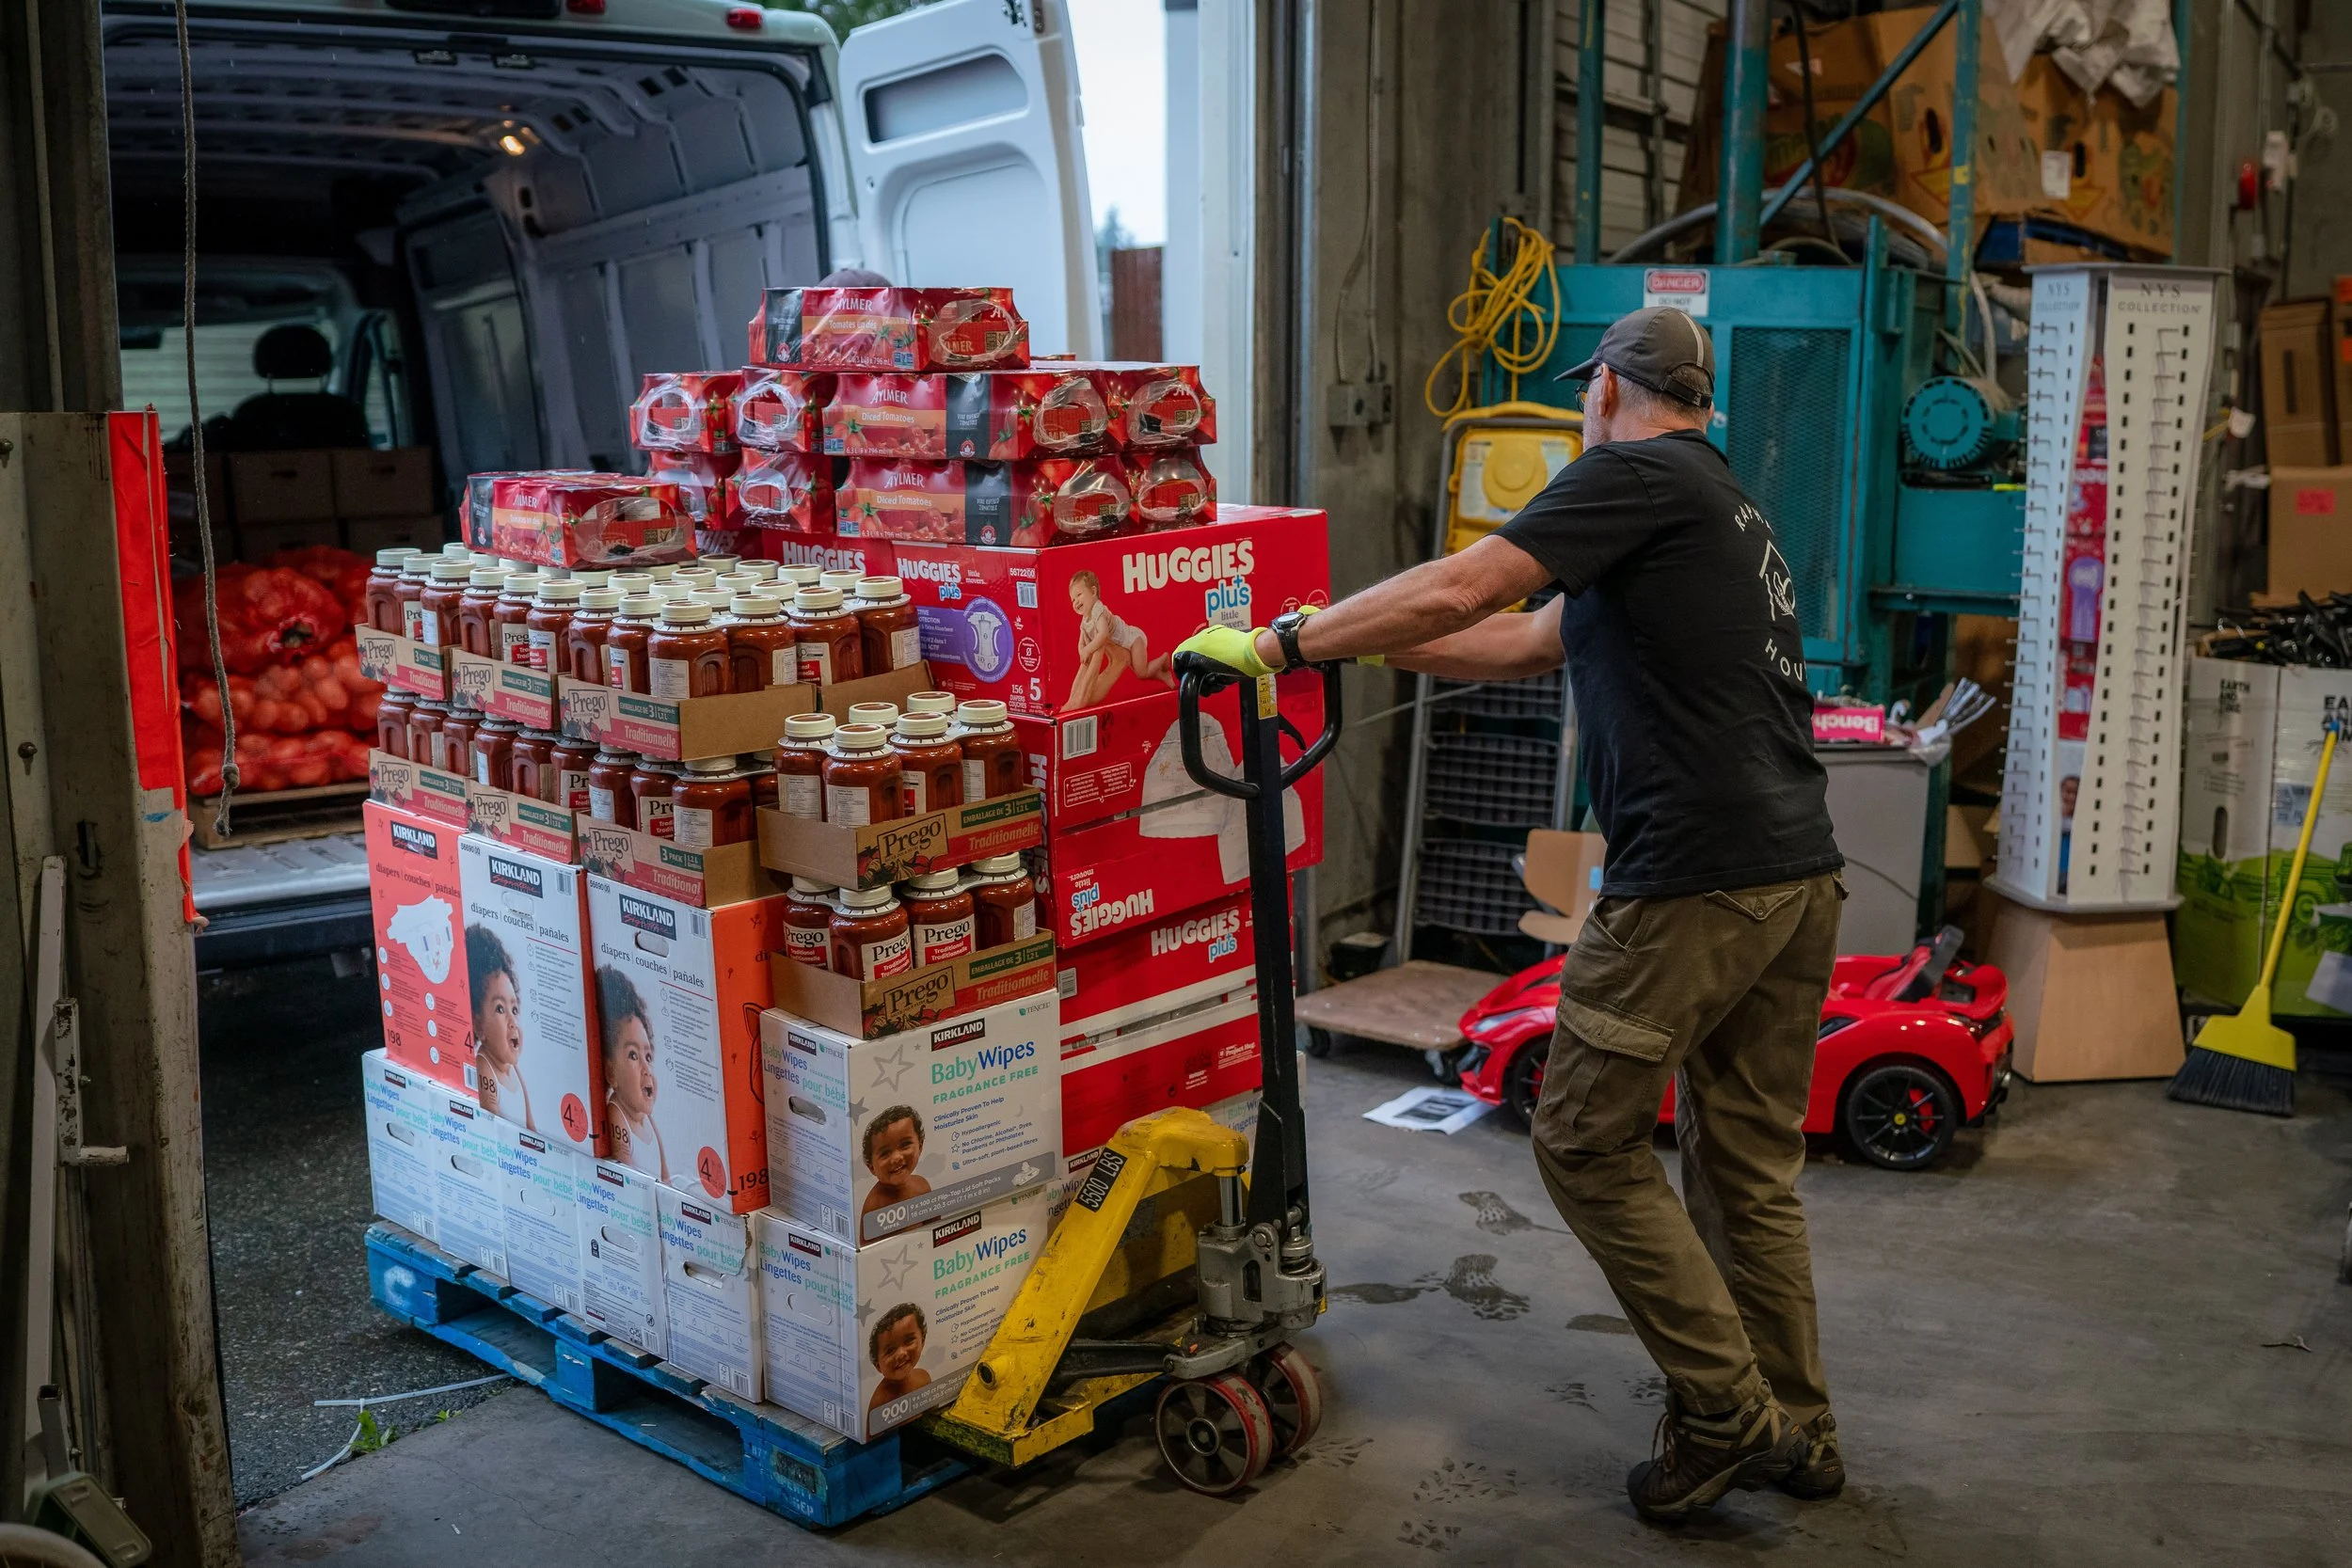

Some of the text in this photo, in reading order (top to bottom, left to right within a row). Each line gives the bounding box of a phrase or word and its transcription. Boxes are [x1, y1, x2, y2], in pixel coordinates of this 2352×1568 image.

[2140, 282, 2182, 297] NYS
[2119, 301, 2201, 314] COLLECTION
[869, 388, 909, 404] AYLMER
[862, 411, 914, 423] Diced Tomatoes
[884, 472, 925, 488] AYLMER
[877, 495, 932, 507] Diced Tomatoes
[783, 541, 866, 572] HUGGIES
[1122, 541, 1255, 594] HUGGIES
[898, 558, 961, 584] HUGGIES
[940, 583, 961, 600] plus
[1206, 575, 1251, 617] plus
[406, 610, 422, 621] Pre
[1220, 610, 1239, 621] little
[504, 631, 530, 643] Preg
[368, 641, 394, 664] Prego
[1764, 638, 1808, 682] HOU
[409, 670, 441, 691] Traditional
[463, 665, 491, 690] Prego
[1011, 685, 1024, 694] 156
[1029, 677, 1041, 702] 5
[506, 697, 548, 721] Traditionnelle
[571, 692, 606, 719] Prego
[649, 705, 654, 718] 3
[625, 725, 676, 749] Traditionnelle
[381, 764, 409, 789] Prego
[423, 796, 467, 819] Traditionnelle
[476, 797, 506, 822] Prego
[962, 810, 995, 824] EMBALLAGE
[1005, 802, 1012, 816] 3
[392, 824, 436, 848] KIRKLAND
[522, 831, 567, 853] Traditionnelle
[593, 831, 628, 859] Prego
[882, 820, 941, 857] Prego
[969, 822, 1039, 851] Traditionnelle
[661, 847, 667, 861] 3
[376, 863, 461, 898] diapers couches pañales
[491, 859, 541, 886] KIRKLAND
[653, 870, 702, 895] Traditional
[1072, 881, 1101, 912] plus
[471, 902, 569, 943] diapers couches pañales
[622, 898, 674, 927] KIRKLAND
[1071, 889, 1154, 937] HUGGIES
[786, 927, 824, 948] Prego
[924, 920, 971, 943] Prego
[1151, 909, 1241, 957] HUGGIES
[931, 946, 968, 960] Traditionnelle
[934, 941, 964, 954] Traditional
[1208, 932, 1238, 963] plus
[601, 942, 705, 989] diapers couches pañales
[972, 959, 1005, 974] EMBALLAGE
[1015, 951, 1022, 964] 3
[892, 974, 948, 1014] Prego
[977, 969, 1049, 1001] Traditionnelle
[387, 1028, 402, 1047] 198
[933, 1021, 984, 1044] KIRKLAND
[763, 1041, 807, 1070] BabyWipes
[931, 1040, 1035, 1085] BabyWipes
[478, 1074, 496, 1093] 198
[764, 1059, 800, 1085] Lingettes
[803, 1078, 822, 1092] pour
[933, 1065, 1039, 1104] FRAGRANCE FREE
[367, 1091, 394, 1113] Lingettes
[933, 1110, 960, 1122] Clinically
[961, 1103, 981, 1115] Proven
[991, 1097, 1005, 1105] Help
[564, 1103, 574, 1128] 4
[933, 1113, 978, 1132] Moisturize Skin
[961, 1119, 1001, 1135] Hypoallergenic
[430, 1124, 460, 1145] Lingettes
[612, 1123, 629, 1144] 198
[497, 1142, 537, 1168] BabyWipes
[1070, 1151, 1099, 1168] KIRKLAND
[498, 1157, 550, 1190] Lingettes pour
[700, 1158, 711, 1182] 4
[739, 1168, 769, 1191] 198
[1082, 1151, 1123, 1208] 5500 LBS
[937, 1190, 961, 1203] Flip-Top
[961, 1185, 971, 1194] Lid
[972, 1181, 983, 1190] Soft
[984, 1177, 1001, 1185] Packs
[577, 1191, 609, 1214] Lingettes
[611, 1208, 628, 1222] pour
[682, 1204, 710, 1220] KIRKLAND
[877, 1206, 907, 1227] 900
[933, 1202, 946, 1211] 20.3
[935, 1214, 979, 1240] KIRKLAND
[697, 1245, 718, 1260] pour
[790, 1235, 820, 1252] KIRKLAND
[933, 1228, 1027, 1281] BabyWipes
[759, 1242, 811, 1272] BabyWipes
[760, 1258, 802, 1285] Lingettes
[805, 1278, 828, 1294] pour
[934, 1251, 1031, 1299] FRAGRANCE FREE
[936, 1302, 959, 1316] Clinically
[960, 1294, 978, 1306] Proven
[987, 1285, 999, 1293] Help
[964, 1304, 976, 1312] Skin
[882, 1400, 908, 1421] 900
